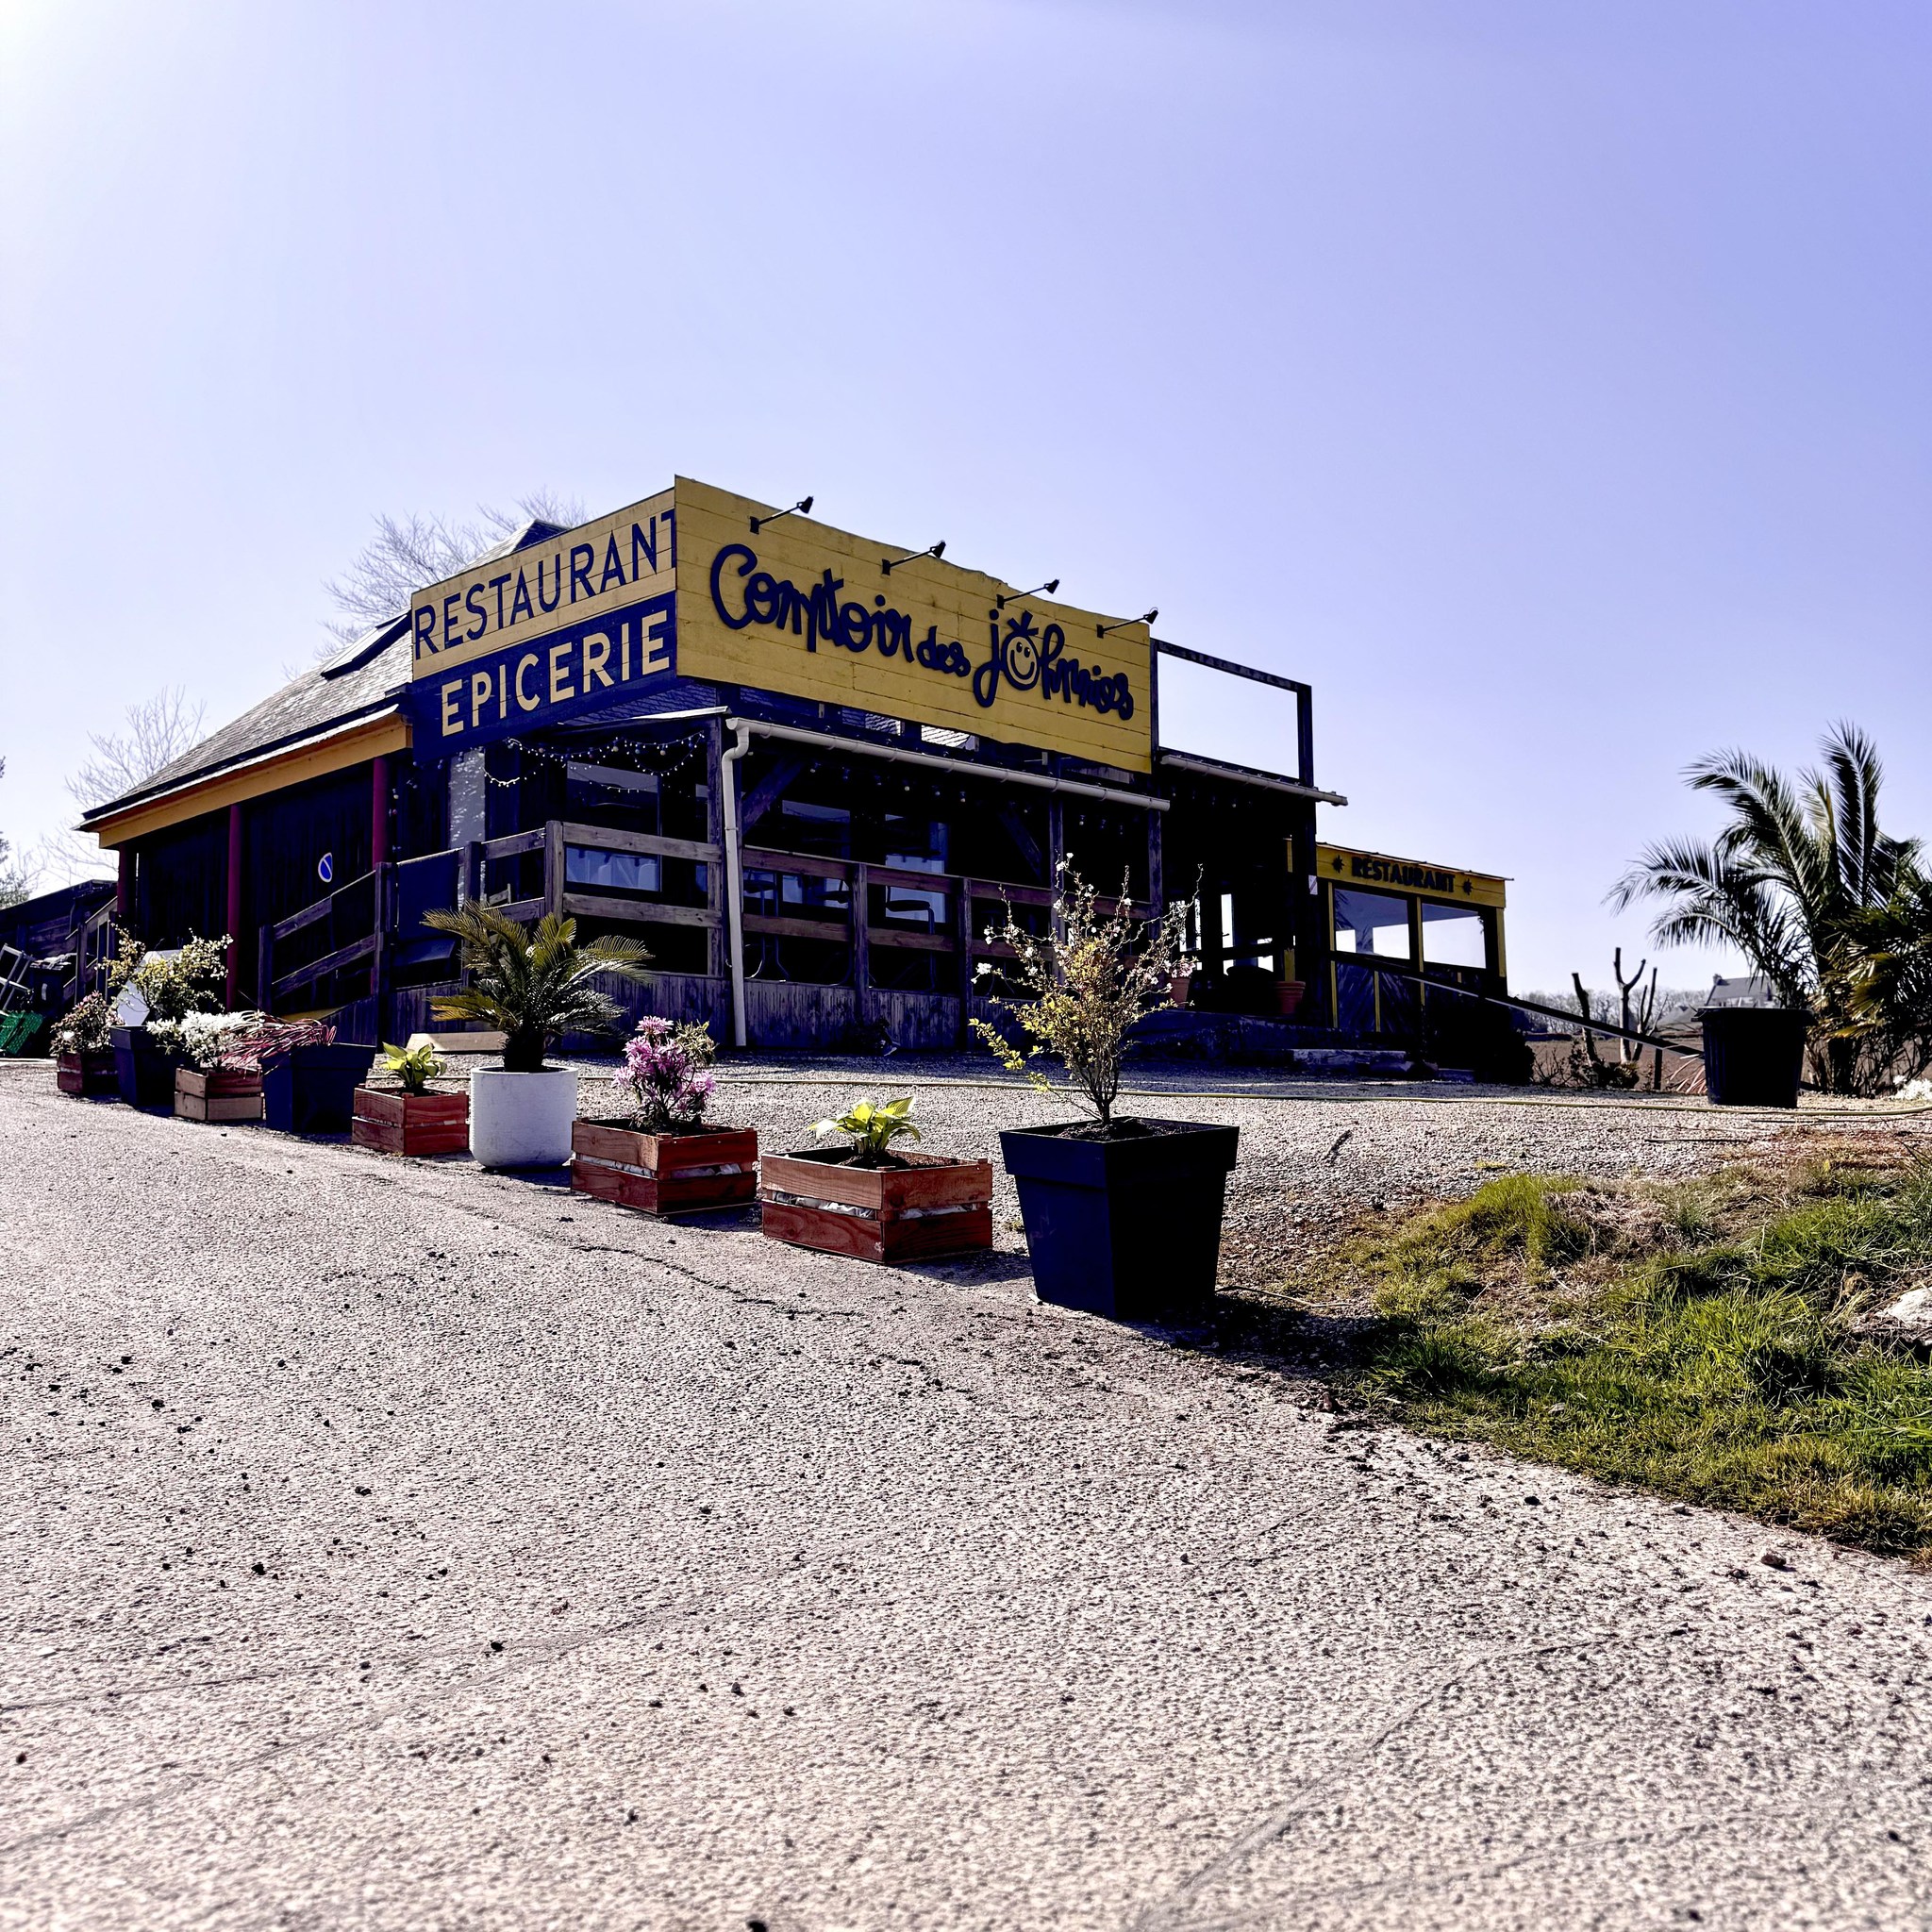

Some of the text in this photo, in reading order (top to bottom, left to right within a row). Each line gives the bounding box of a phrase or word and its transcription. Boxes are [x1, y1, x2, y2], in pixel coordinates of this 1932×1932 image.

[414, 508, 676, 659] RESTAURANT
[710, 543, 914, 662] Comptoir
[916, 625, 971, 677] des
[441, 609, 670, 737] EPICERIE
[1351, 856, 1456, 892] RESTAURANT
